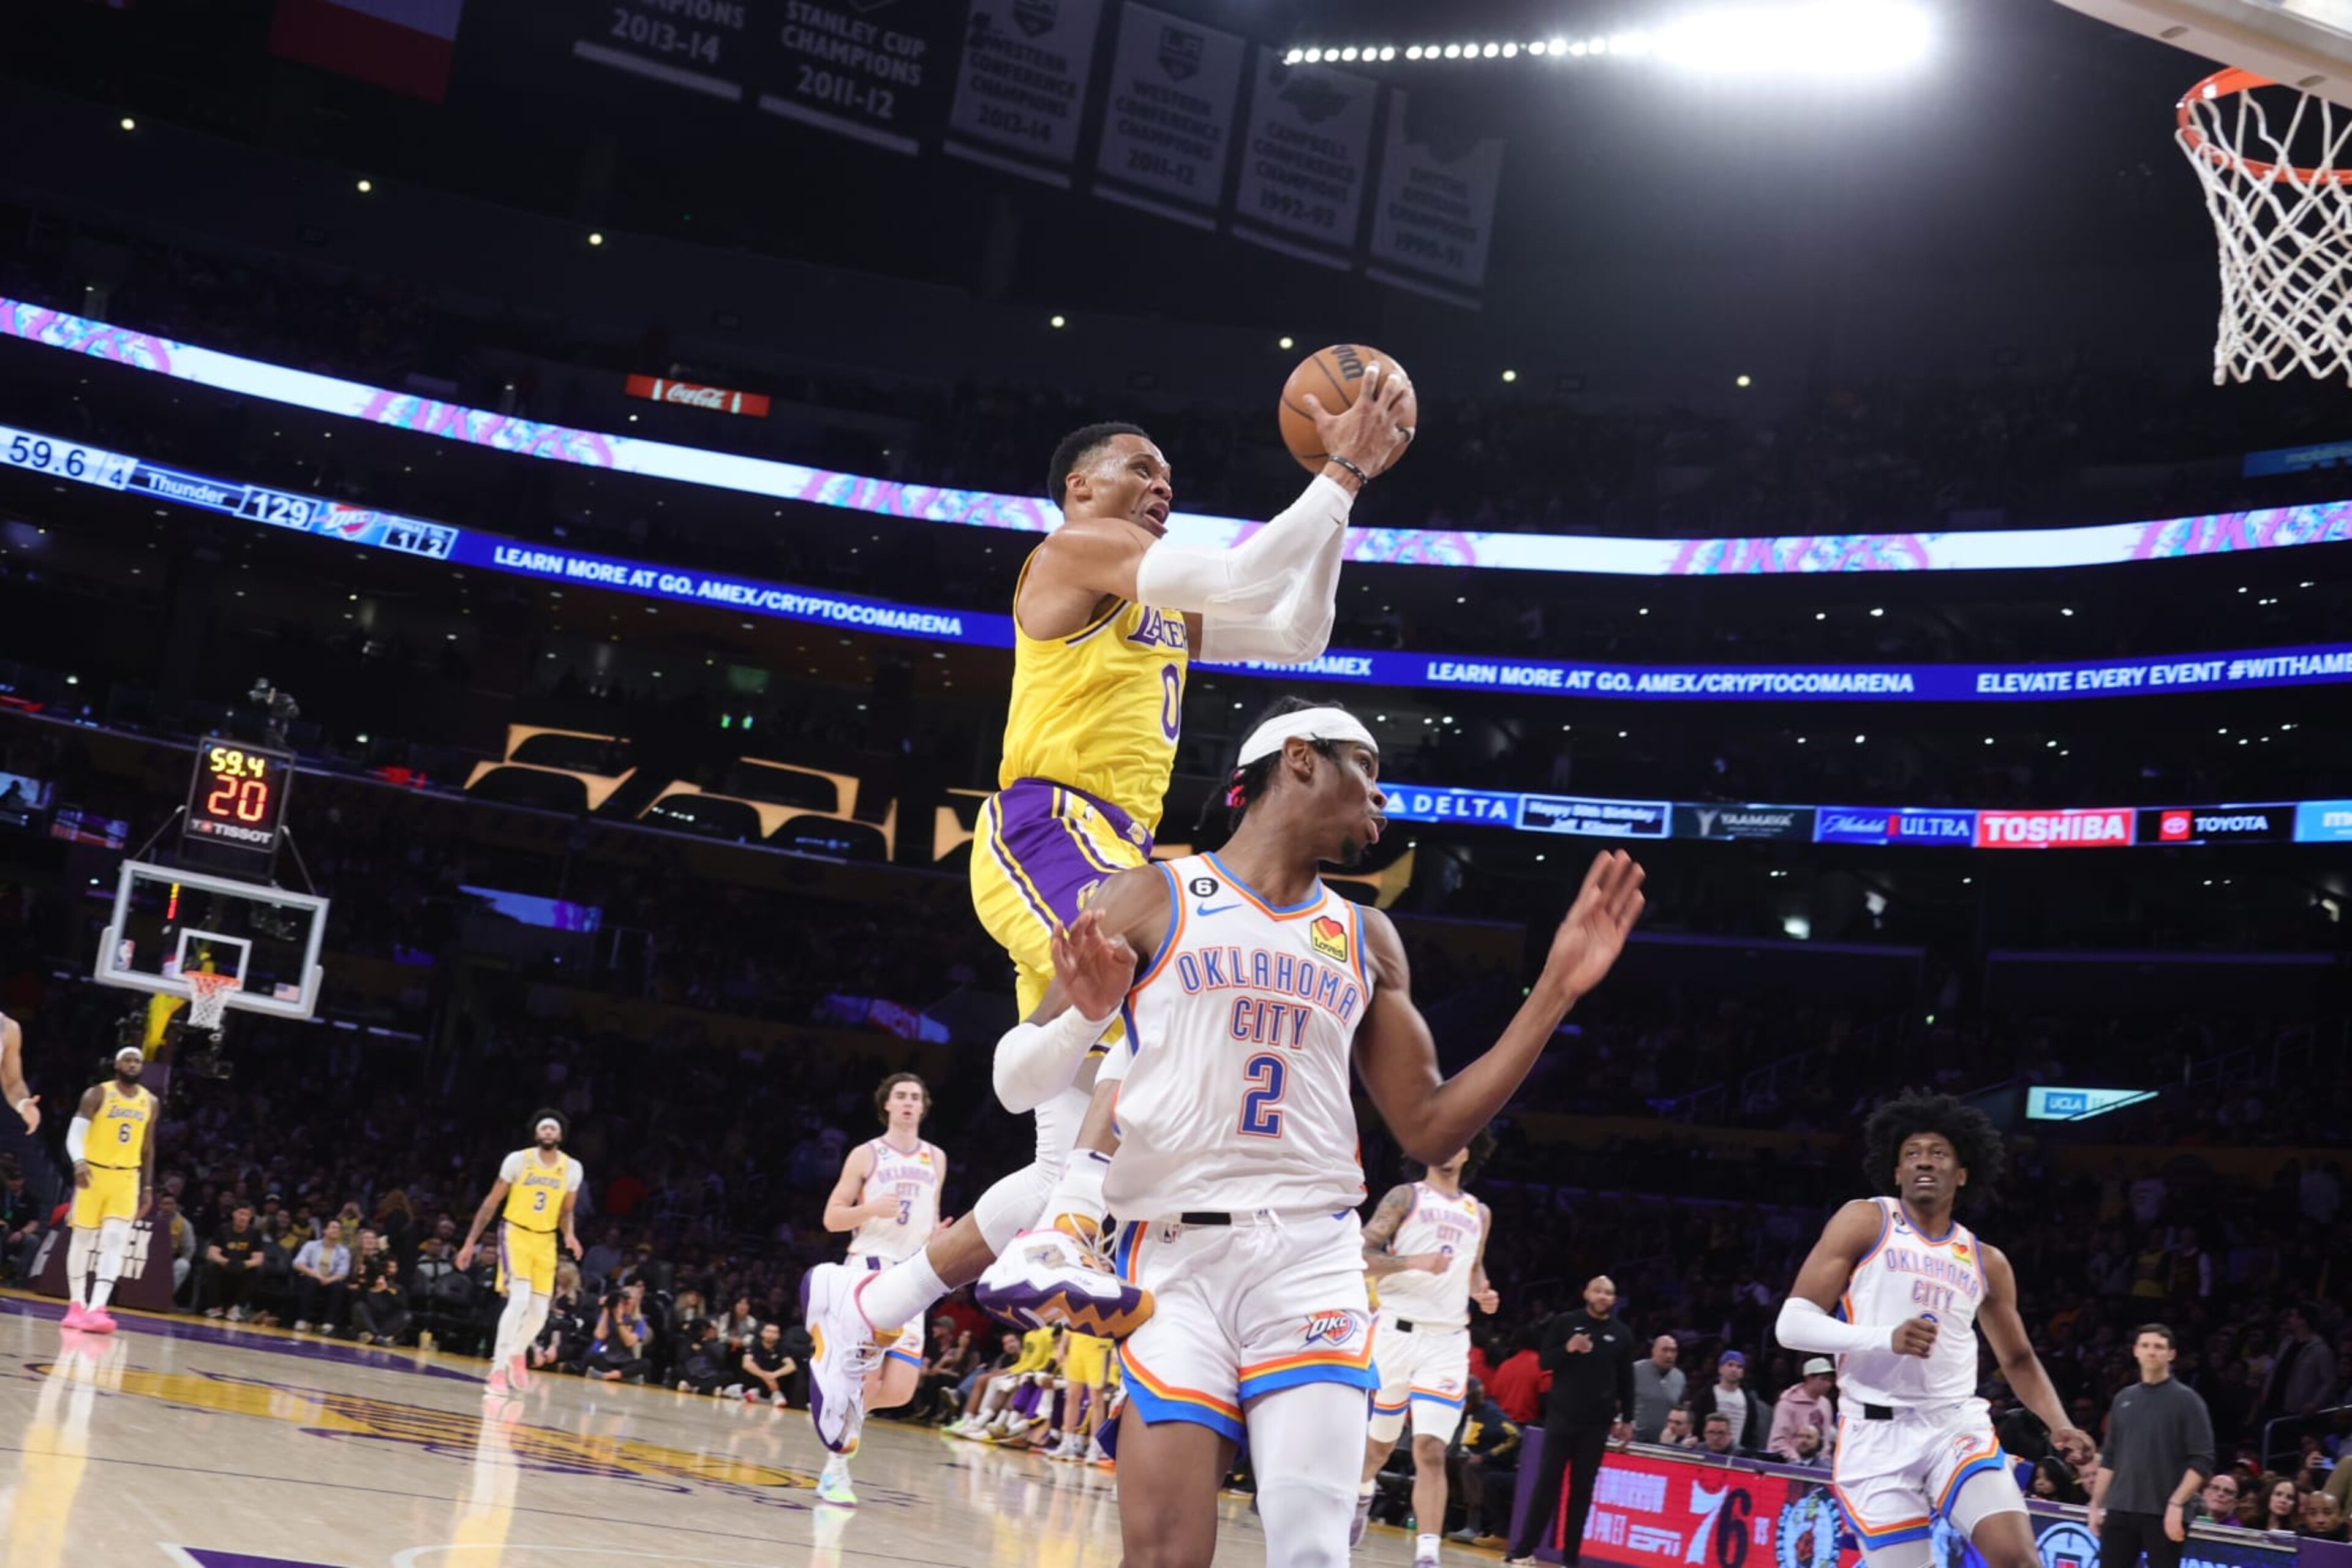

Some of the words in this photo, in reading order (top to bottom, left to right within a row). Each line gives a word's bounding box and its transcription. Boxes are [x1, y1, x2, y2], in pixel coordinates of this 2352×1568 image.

[611, 8, 720, 63] 2013-14
[785, 0, 878, 45] STANLEY
[883, 30, 925, 58] CUP
[780, 25, 923, 87] CHAMPIONS
[796, 64, 894, 119] 2011-12
[1118, 119, 1214, 162] CHAMPIONS
[9, 435, 86, 477] 59.6
[109, 469, 123, 487] 4
[146, 471, 229, 505] Thunder
[252, 494, 310, 527] 129
[398, 532, 410, 548] 1
[428, 538, 443, 556] 2
[494, 546, 564, 573] LEARN
[565, 559, 628, 585] MORE
[628, 570, 658, 589] AT
[658, 573, 695, 596] GO.
[696, 581, 963, 636] AMEX/CRYPTOCOMARENA
[1427, 662, 1498, 683] LEARN
[1500, 666, 1564, 688] MORE
[1565, 671, 1595, 689] AT
[1596, 673, 1634, 691] GO.
[1635, 673, 1915, 693] AMEX/CRYPTOCOMARENA
[1976, 672, 2072, 693] ELEVATE
[2075, 666, 2146, 690] EVERY
[2149, 661, 2225, 685] EVENT
[1161, 662, 1182, 745] 0
[209, 747, 265, 778] 59.4
[207, 774, 268, 822] 20
[1412, 794, 1509, 819] DELTA
[214, 823, 273, 844] TISSOT
[1900, 818, 1969, 837] ULTRA
[1984, 815, 2125, 842] TOSHIBA
[2194, 815, 2268, 832] TOYOTA
[1196, 880, 1213, 895] 6
[1175, 946, 1360, 1025] OKLAHOMA
[1230, 997, 1312, 1050] CITY
[1237, 1052, 1287, 1139] 2
[119, 1123, 131, 1143] 6
[532, 1190, 547, 1212] 3
[896, 1200, 911, 1226] 3
[1884, 1248, 1979, 1300] OKLAHOMA
[1912, 1280, 1954, 1314] CITY
[1306, 1315, 1348, 1341] OKC
